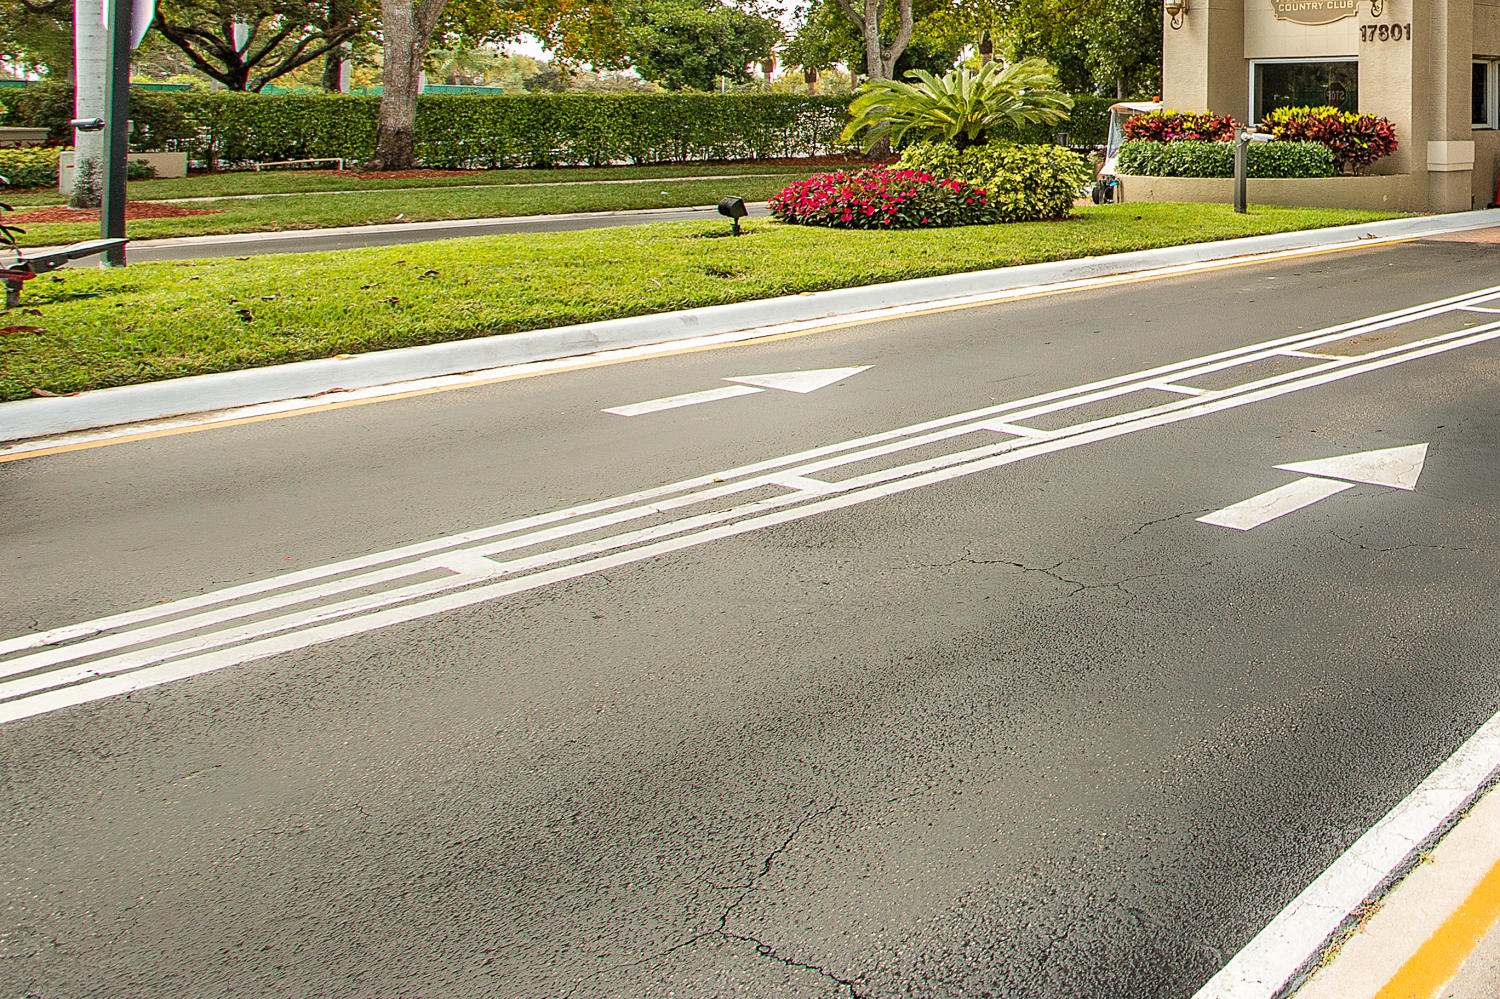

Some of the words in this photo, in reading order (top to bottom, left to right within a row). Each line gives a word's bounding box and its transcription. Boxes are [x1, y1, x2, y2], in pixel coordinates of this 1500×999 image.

[1278, 1, 1323, 12] COUNTRY
[1327, 0, 1354, 9] CLUB
[1359, 23, 1411, 42] 17801
